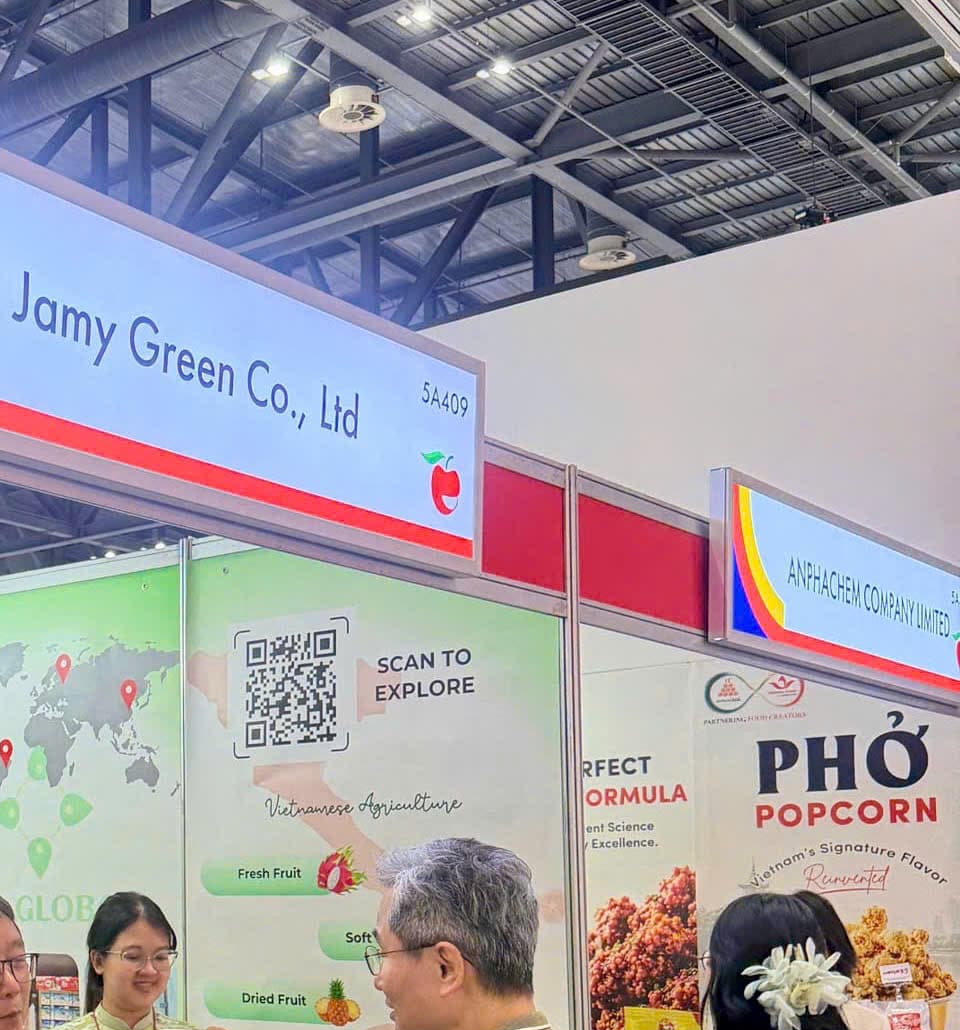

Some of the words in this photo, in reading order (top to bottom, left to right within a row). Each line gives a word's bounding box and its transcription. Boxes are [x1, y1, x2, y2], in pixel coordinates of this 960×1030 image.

[12, 270, 117, 367] Jamy
[130, 315, 235, 397] Green
[246, 359, 306, 431] Co.,
[320, 384, 359, 440] Ltd
[421, 380, 470, 418] 5A409
[787, 556, 861, 606] ANPHACHEM
[863, 583, 916, 632] COMPANY
[916, 602, 951, 638] LIMITED
[376, 652, 435, 674] SCAN
[442, 648, 472, 668] TO
[375, 676, 476, 702] EXPLORE
[756, 710, 930, 795] PHỞ
[265, 795, 354, 819] Vietnamese
[359, 792, 463, 820] Agriculture
[585, 784, 688, 807] ORMULA
[755, 797, 938, 829] POPCORN
[607, 821, 655, 834] Science
[591, 837, 659, 849] Excellence.
[238, 867, 270, 880] Fresh
[273, 866, 302, 880] Fruit
[750, 847, 816, 889] Vietnam's
[820, 842, 897, 858] Signature
[900, 852, 949, 885] Flavor
[345, 930, 373, 944] Soft
[242, 992, 275, 1005] Dried
[278, 994, 307, 1007] Fruit
